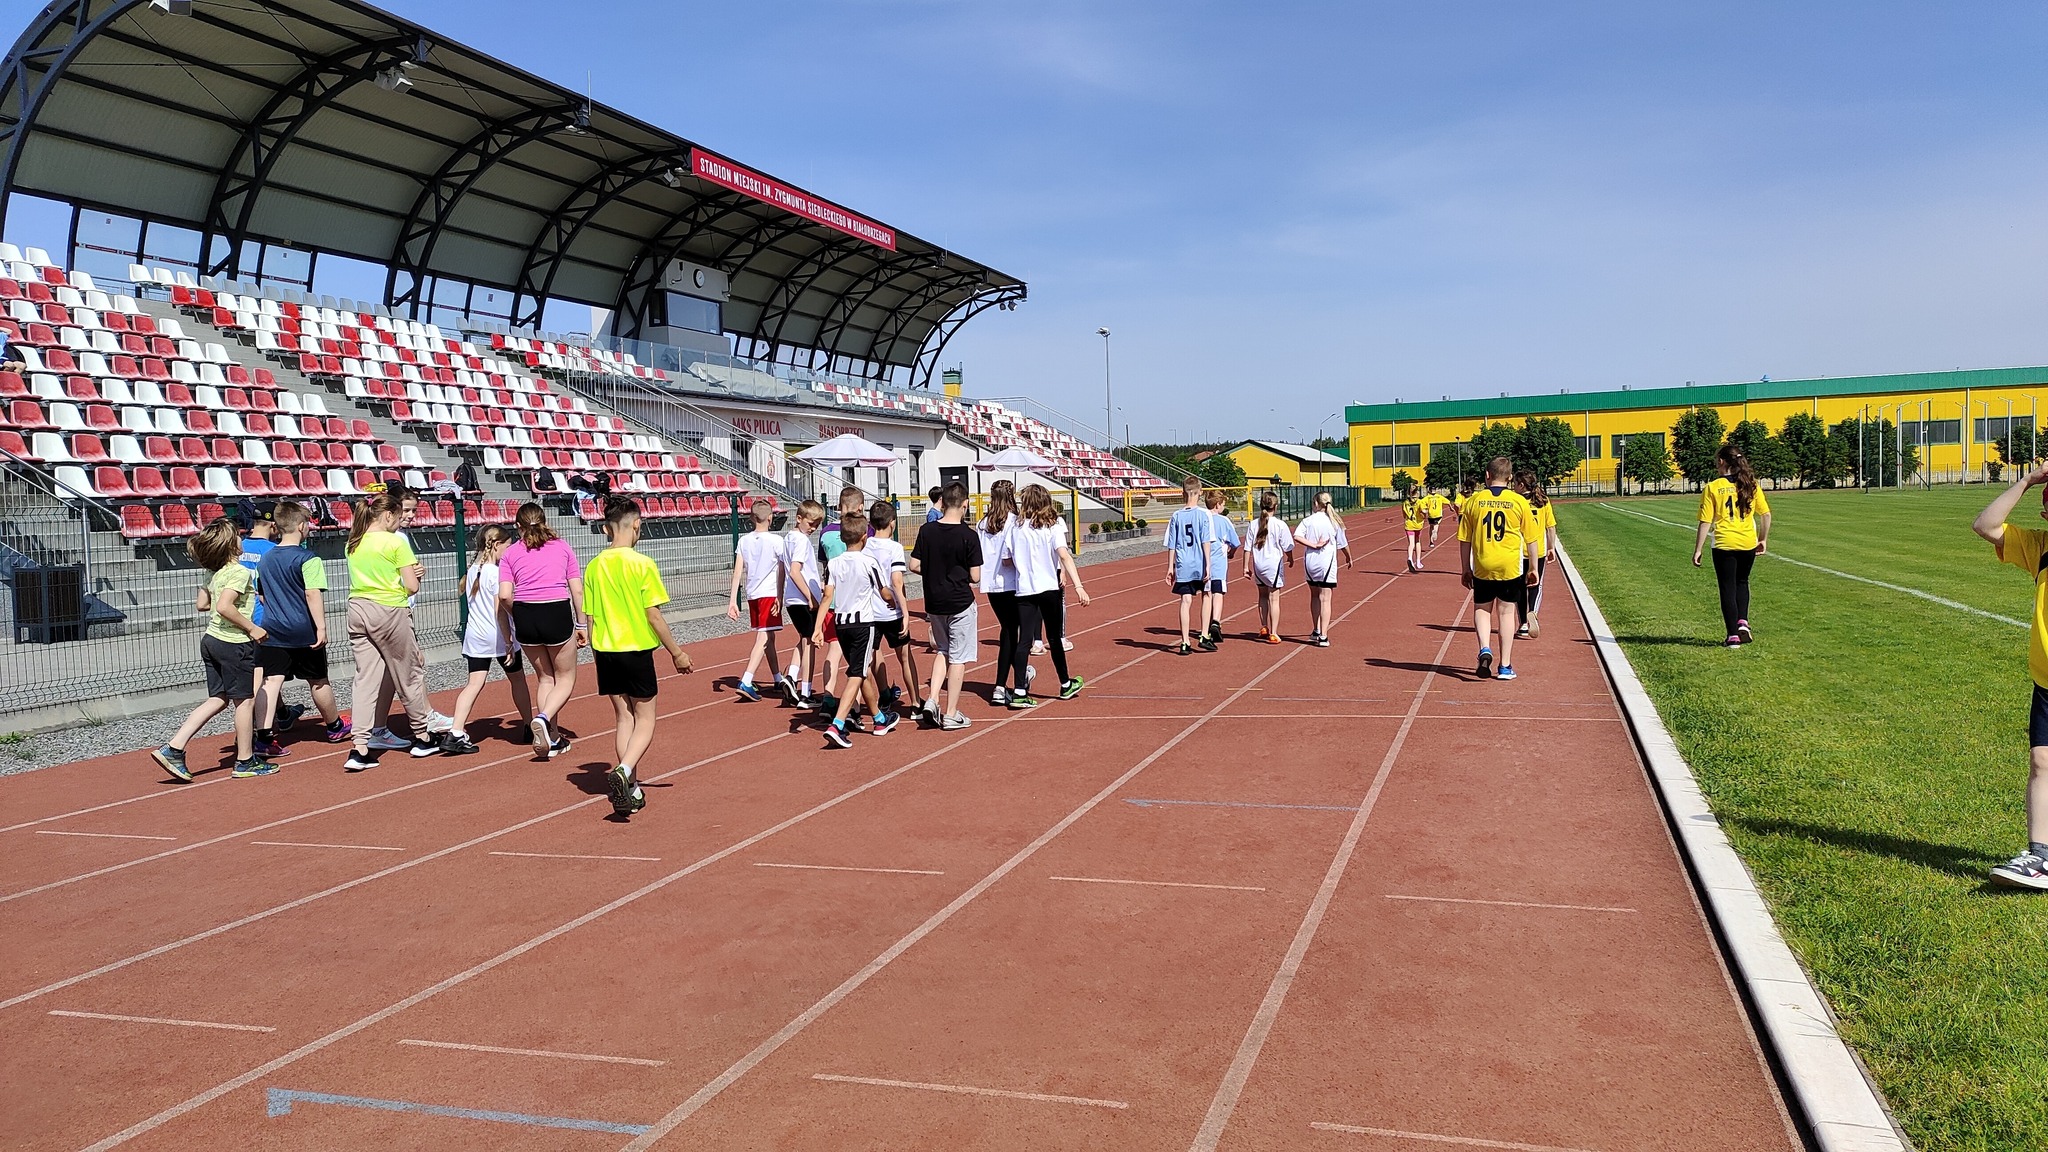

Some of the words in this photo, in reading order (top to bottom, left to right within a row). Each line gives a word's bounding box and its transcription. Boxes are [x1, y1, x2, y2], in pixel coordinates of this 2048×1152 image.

[700, 157, 732, 183] STADION
[733, 171, 761, 195] MIEJSKI
[762, 183, 774, 200] IM.
[774, 188, 807, 212] ZYGMUNTA
[807, 201, 847, 228] SIEDLECKIEGO
[846, 217, 852, 230] W
[852, 220, 891, 246] BIAŁOBRZEGACH
[732, 417, 752, 433] MKS
[753, 419, 782, 436] PILICA
[1185, 523, 1194, 547] 5
[1482, 510, 1506, 542] 19
